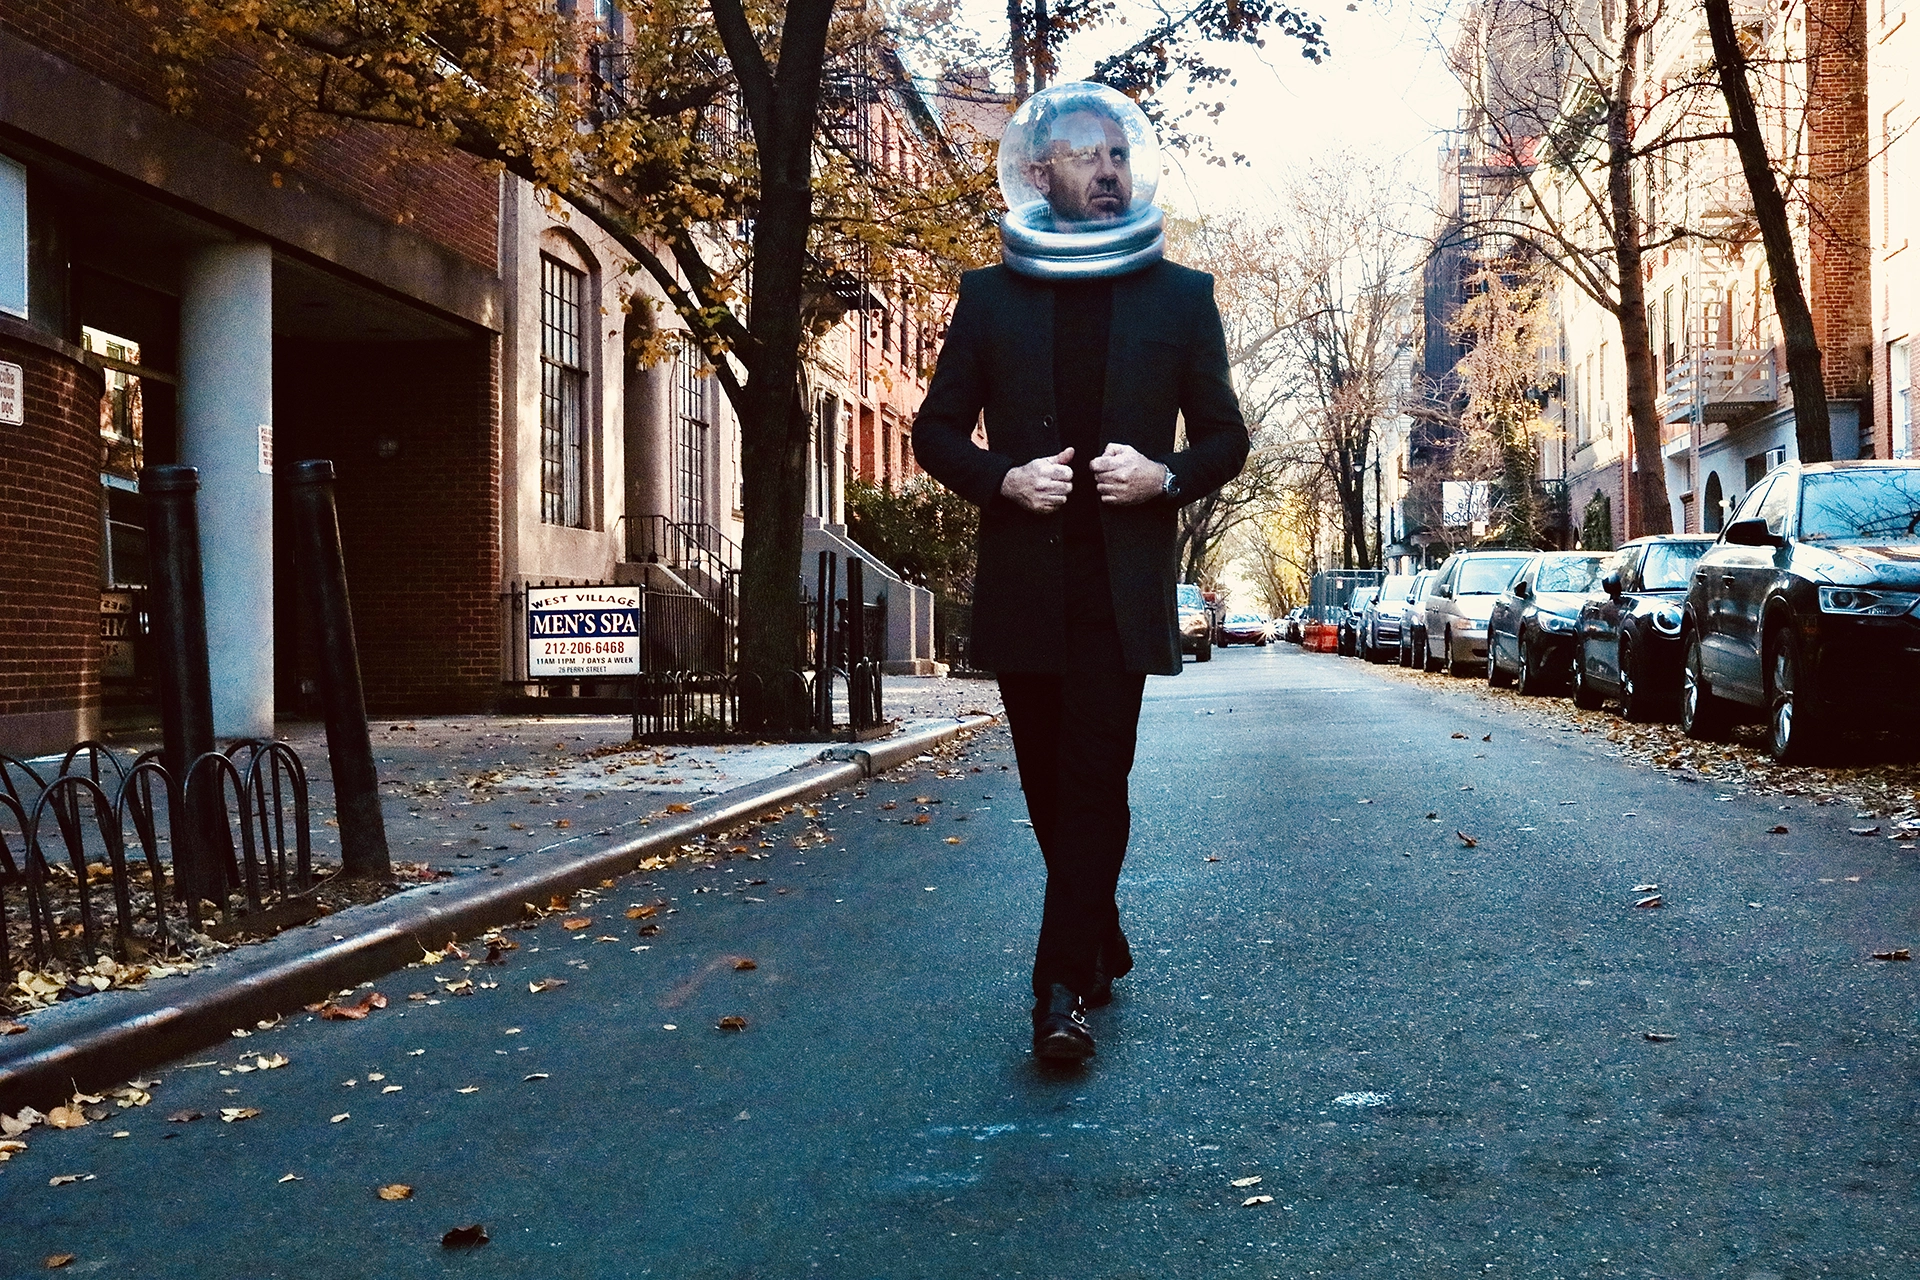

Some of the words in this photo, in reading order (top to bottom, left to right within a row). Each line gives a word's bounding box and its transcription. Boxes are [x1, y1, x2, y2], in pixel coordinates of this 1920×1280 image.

[531, 595, 568, 609] WEST
[576, 594, 636, 608] VILLAGE
[533, 612, 596, 634] MEN'S
[600, 612, 637, 633] SPA
[566, 666, 584, 674] PERRY
[585, 665, 607, 673] STREET
